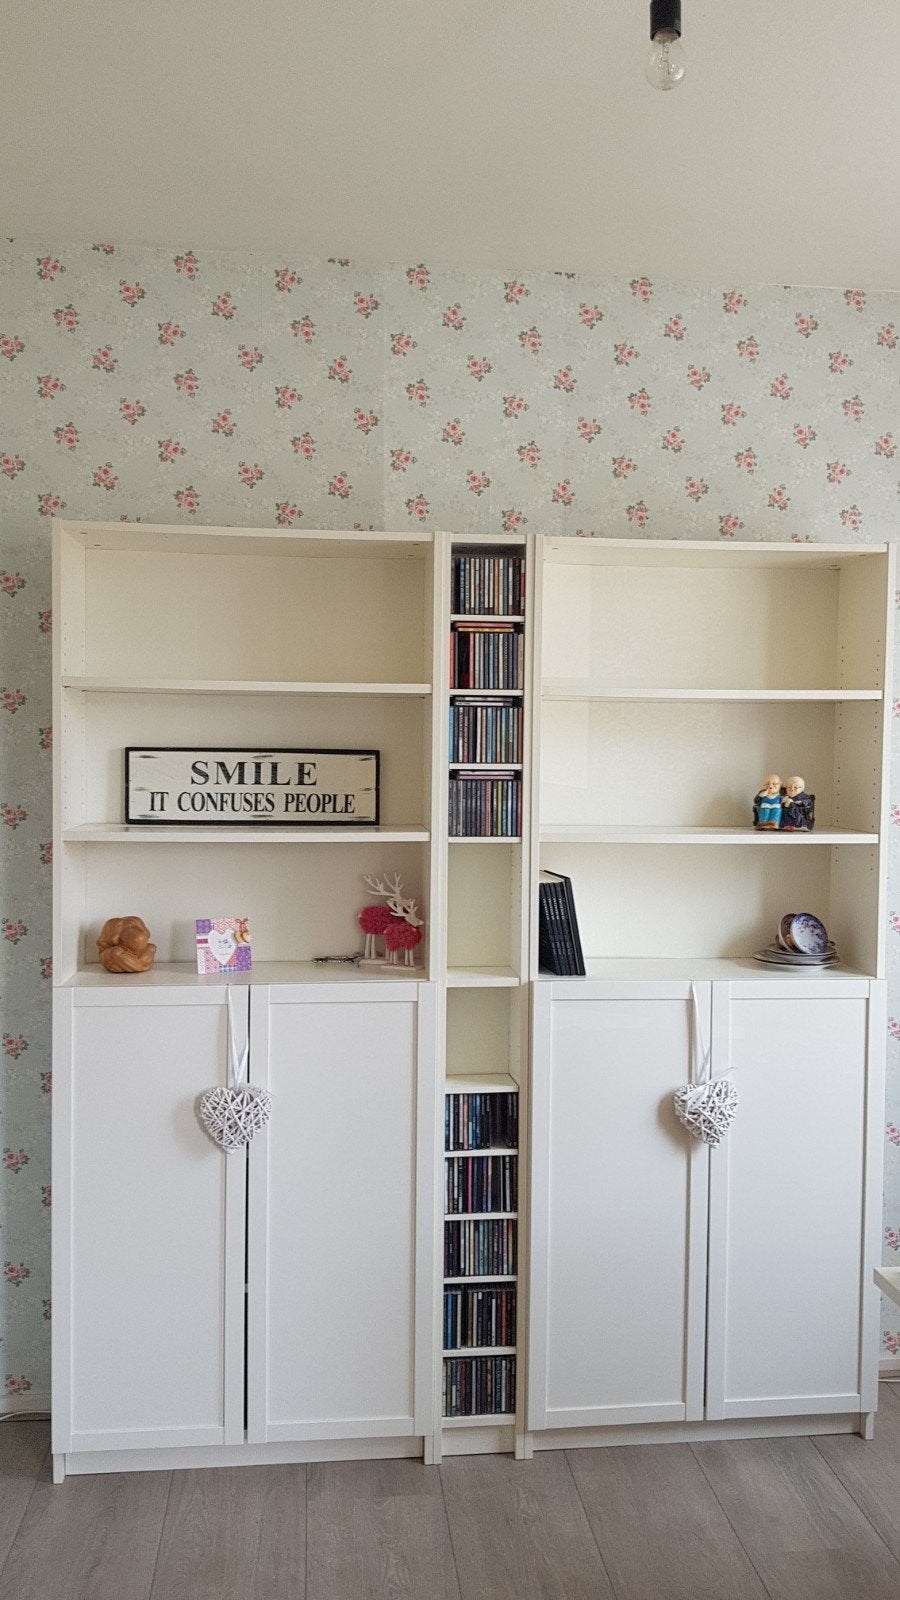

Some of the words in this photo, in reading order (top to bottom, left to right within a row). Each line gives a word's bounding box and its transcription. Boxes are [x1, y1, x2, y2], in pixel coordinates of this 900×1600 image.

[190, 760, 318, 786] SMILE
[149, 791, 169, 812] IT
[177, 791, 275, 813] CONFUSES
[283, 793, 356, 814] PEOPLE
